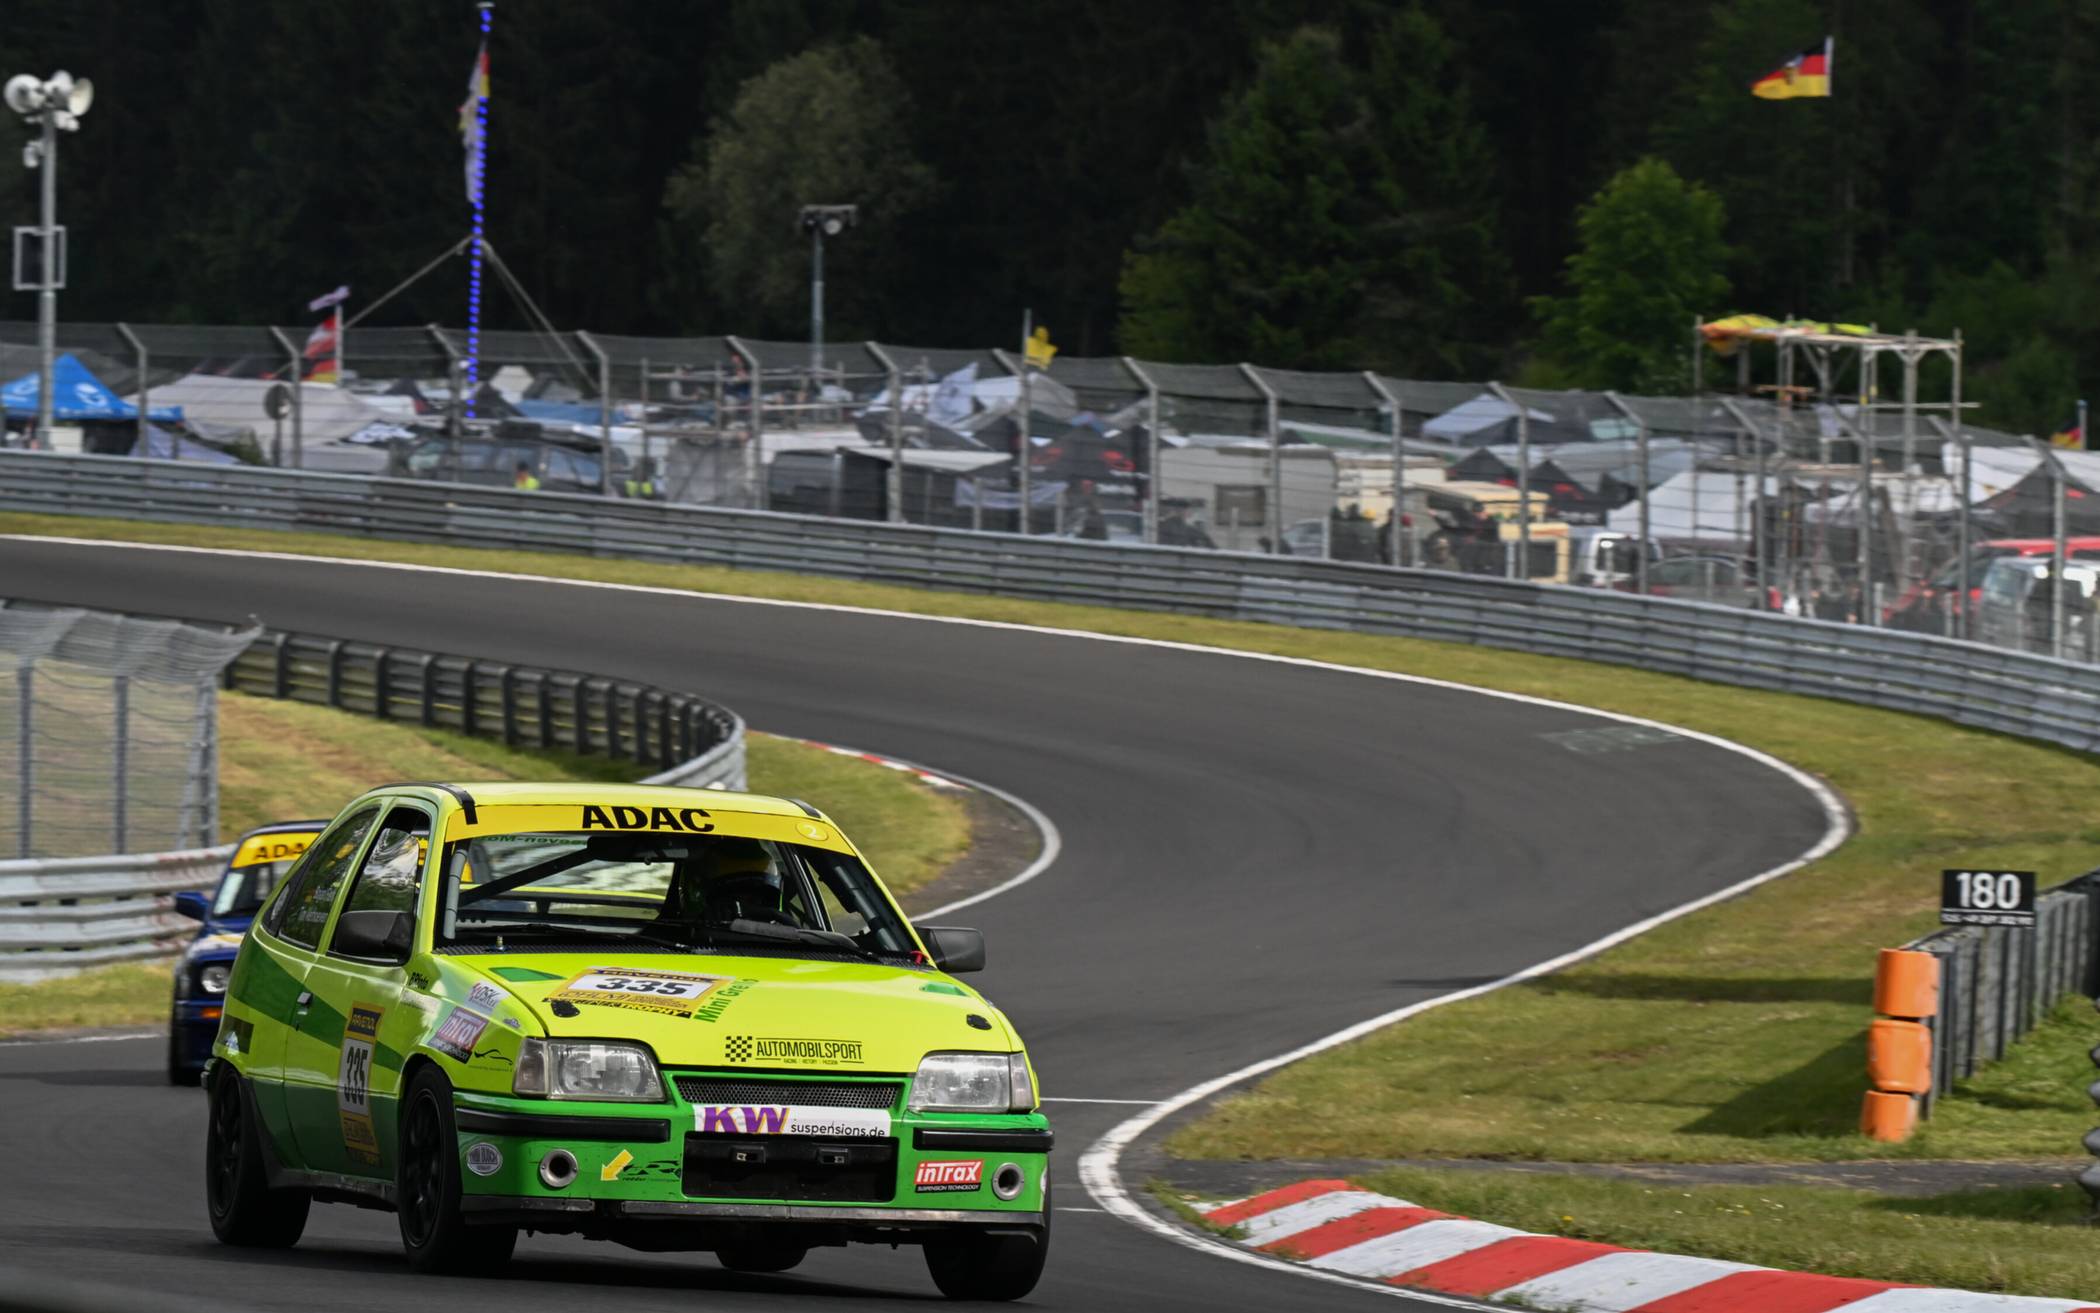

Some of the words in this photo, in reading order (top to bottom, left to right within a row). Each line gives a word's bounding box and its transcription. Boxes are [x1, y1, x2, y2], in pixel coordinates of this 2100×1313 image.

[581, 805, 715, 832] ADAC
[809, 826, 818, 838] 2
[253, 842, 310, 859] ADA
[1956, 872, 2021, 909] 180
[596, 977, 693, 996] 335
[693, 997, 732, 1023] Mini
[756, 1041, 863, 1060] AUTOMOBILSPORT
[344, 1046, 368, 1105] 335
[703, 1107, 790, 1134] KW
[790, 1121, 885, 1136] suspensions.de
[916, 1161, 982, 1183] inTrax
